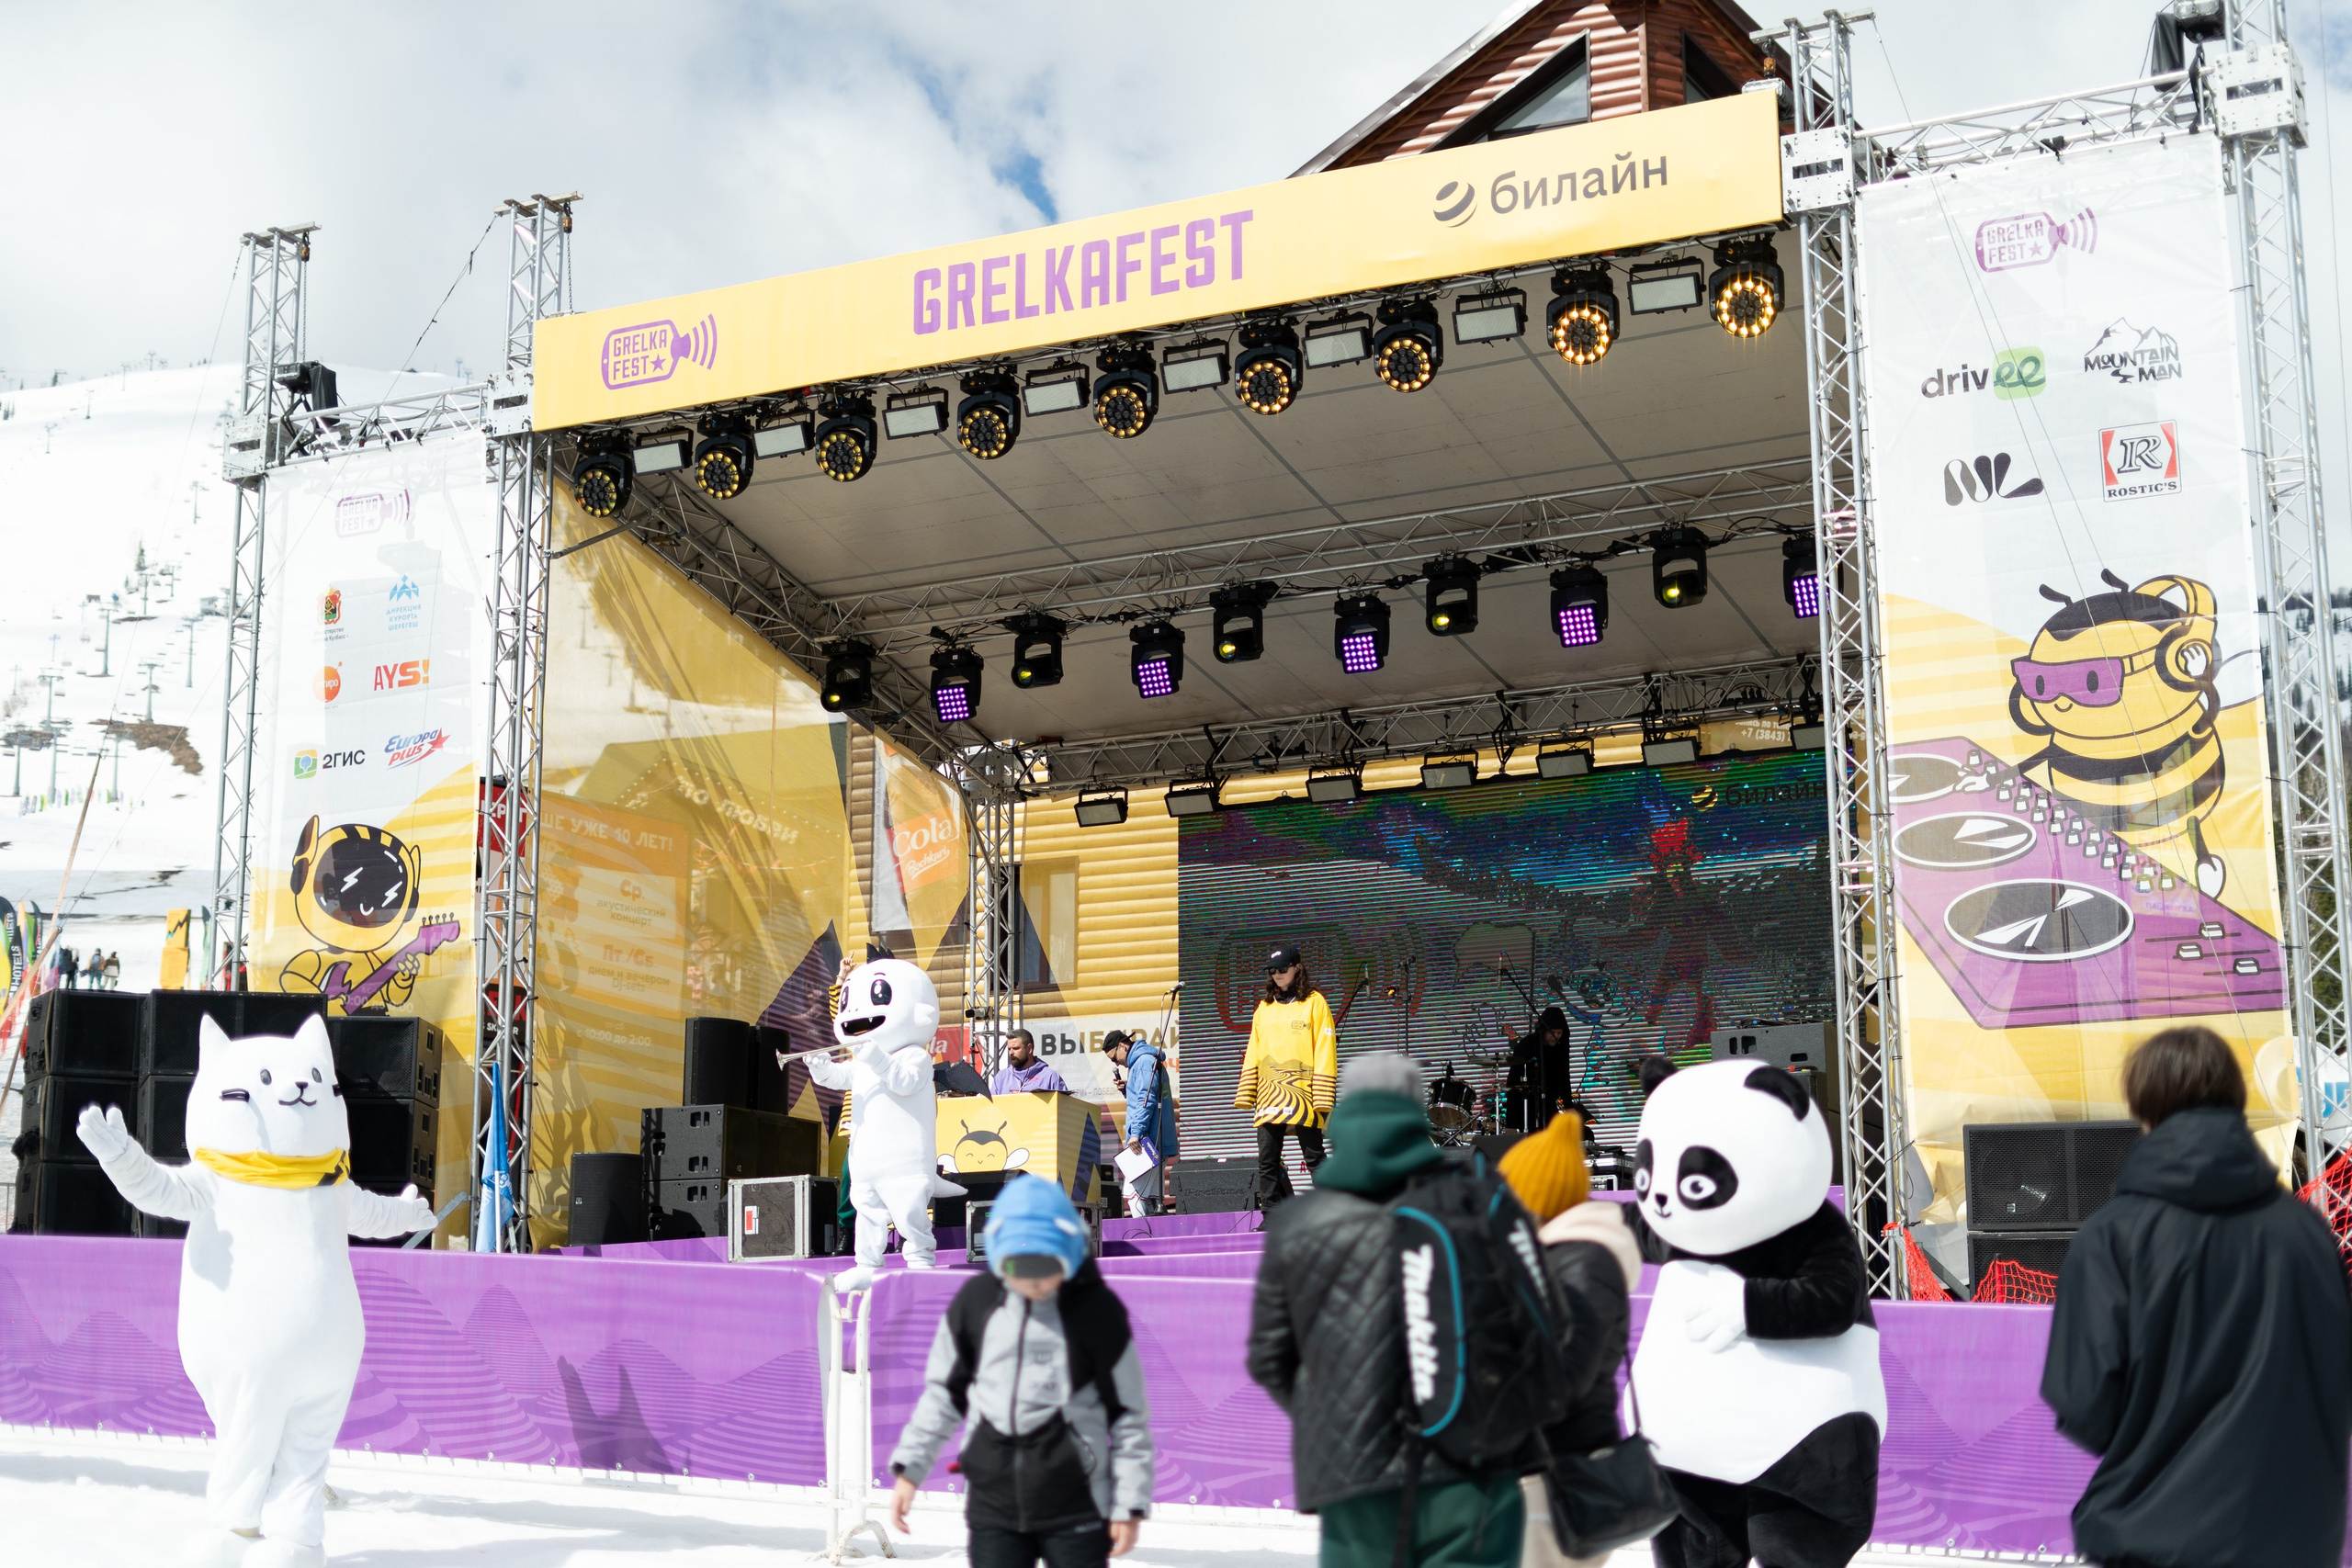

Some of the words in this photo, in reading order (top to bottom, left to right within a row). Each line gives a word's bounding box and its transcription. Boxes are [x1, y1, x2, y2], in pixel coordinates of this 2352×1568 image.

[1490, 151, 1668, 214] билайн
[1986, 220, 2044, 245] GRELKA
[1988, 243, 2026, 265] FEST
[913, 209, 1253, 335] GRELKAFEST
[613, 329, 667, 357] GRELKA
[613, 355, 650, 380] FEST
[2084, 344, 2179, 373] MOUNTAIN
[1921, 355, 2046, 398] drivee
[2138, 362, 2182, 382] MAN
[2107, 481, 2177, 498] ROSTIC'S
[343, 498, 378, 516] GRELKA
[342, 515, 366, 532] FEST
[386, 604, 421, 615] ДИРЕКЦИЯ
[389, 613, 418, 623] КУРОРТА
[388, 621, 419, 631] ШЕРЕГЕШ
[374, 659, 430, 691] AYS!
[1741, 728, 1753, 738] +7
[1755, 729, 1786, 742] (3843)
[322, 750, 366, 769] 2ГИС
[571, 818, 609, 840] УЖЕ
[615, 827, 631, 844] 10
[636, 831, 673, 852] ЛЕТ!
[892, 817, 953, 857] Cola
[597, 899, 666, 919] акустический
[610, 912, 653, 927] концерт
[588, 965, 615, 977] днем
[627, 971, 670, 986] вечером
[612, 978, 646, 993] Dj-sets
[586, 1029, 612, 1041] 10:00
[613, 1034, 627, 1043] до
[629, 1034, 651, 1046] 2:00
[1041, 1020, 1180, 1055] ВЫБРАЙ
